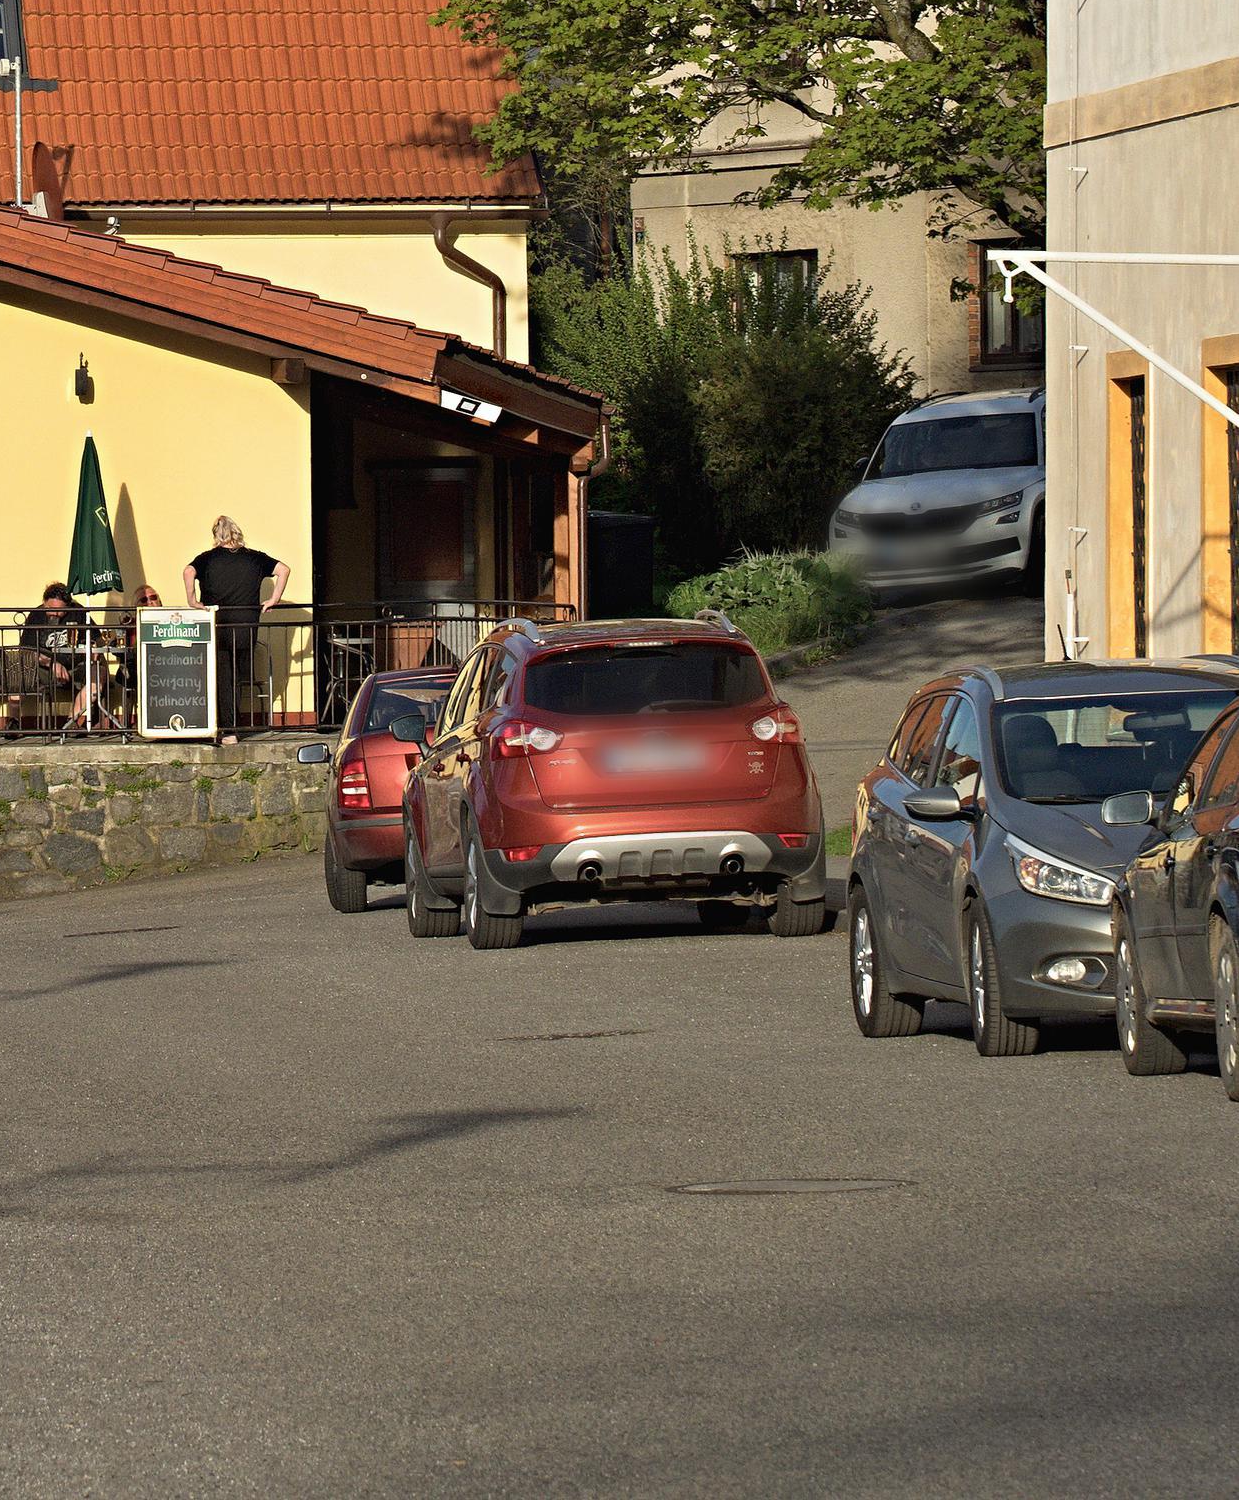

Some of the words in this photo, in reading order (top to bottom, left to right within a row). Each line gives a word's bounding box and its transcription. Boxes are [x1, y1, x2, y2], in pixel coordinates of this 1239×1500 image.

[152, 623, 200, 638] Ferdinand
[148, 652, 203, 666] Ferdinand
[150, 674, 202, 693] Svijany
[150, 694, 206, 708] Malinovka
